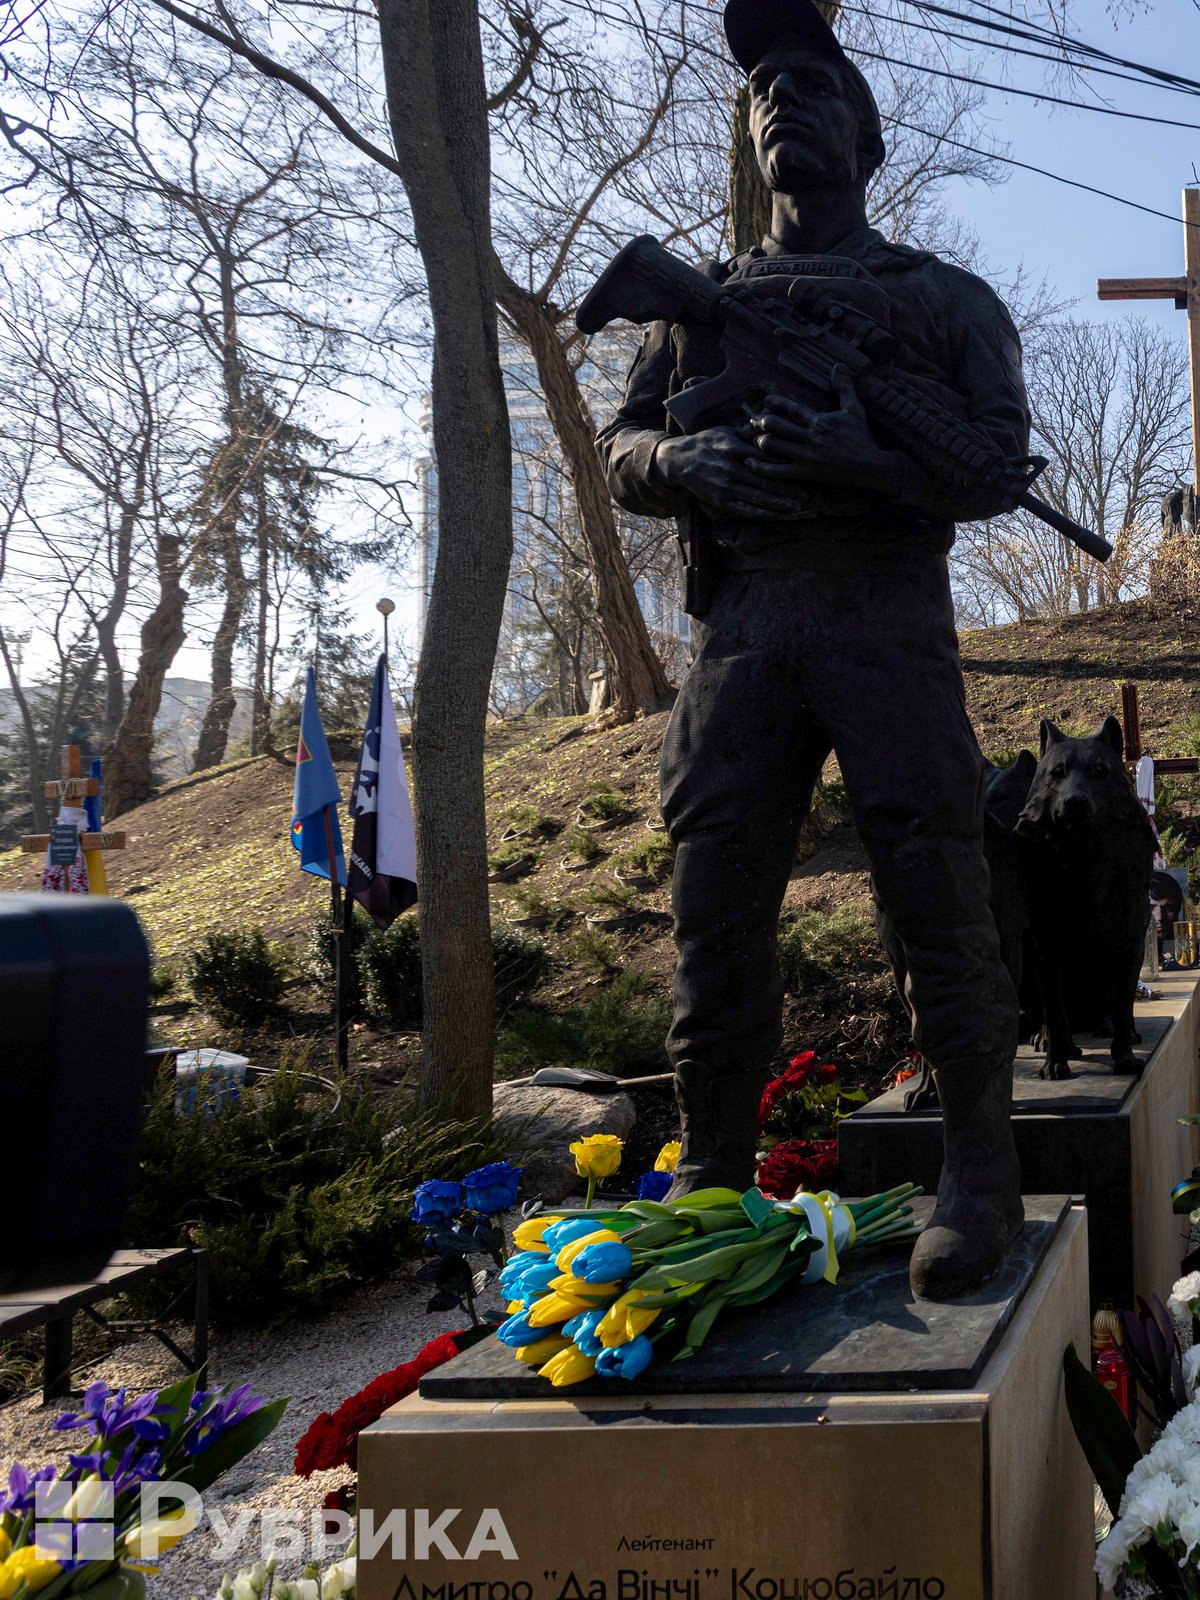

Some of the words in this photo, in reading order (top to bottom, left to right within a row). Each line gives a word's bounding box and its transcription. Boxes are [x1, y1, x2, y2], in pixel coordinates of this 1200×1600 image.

[617, 1535, 714, 1551] Лейтенант
[392, 1573, 533, 1600] Дмитро
[731, 1566, 945, 1600] Коцюбайло
